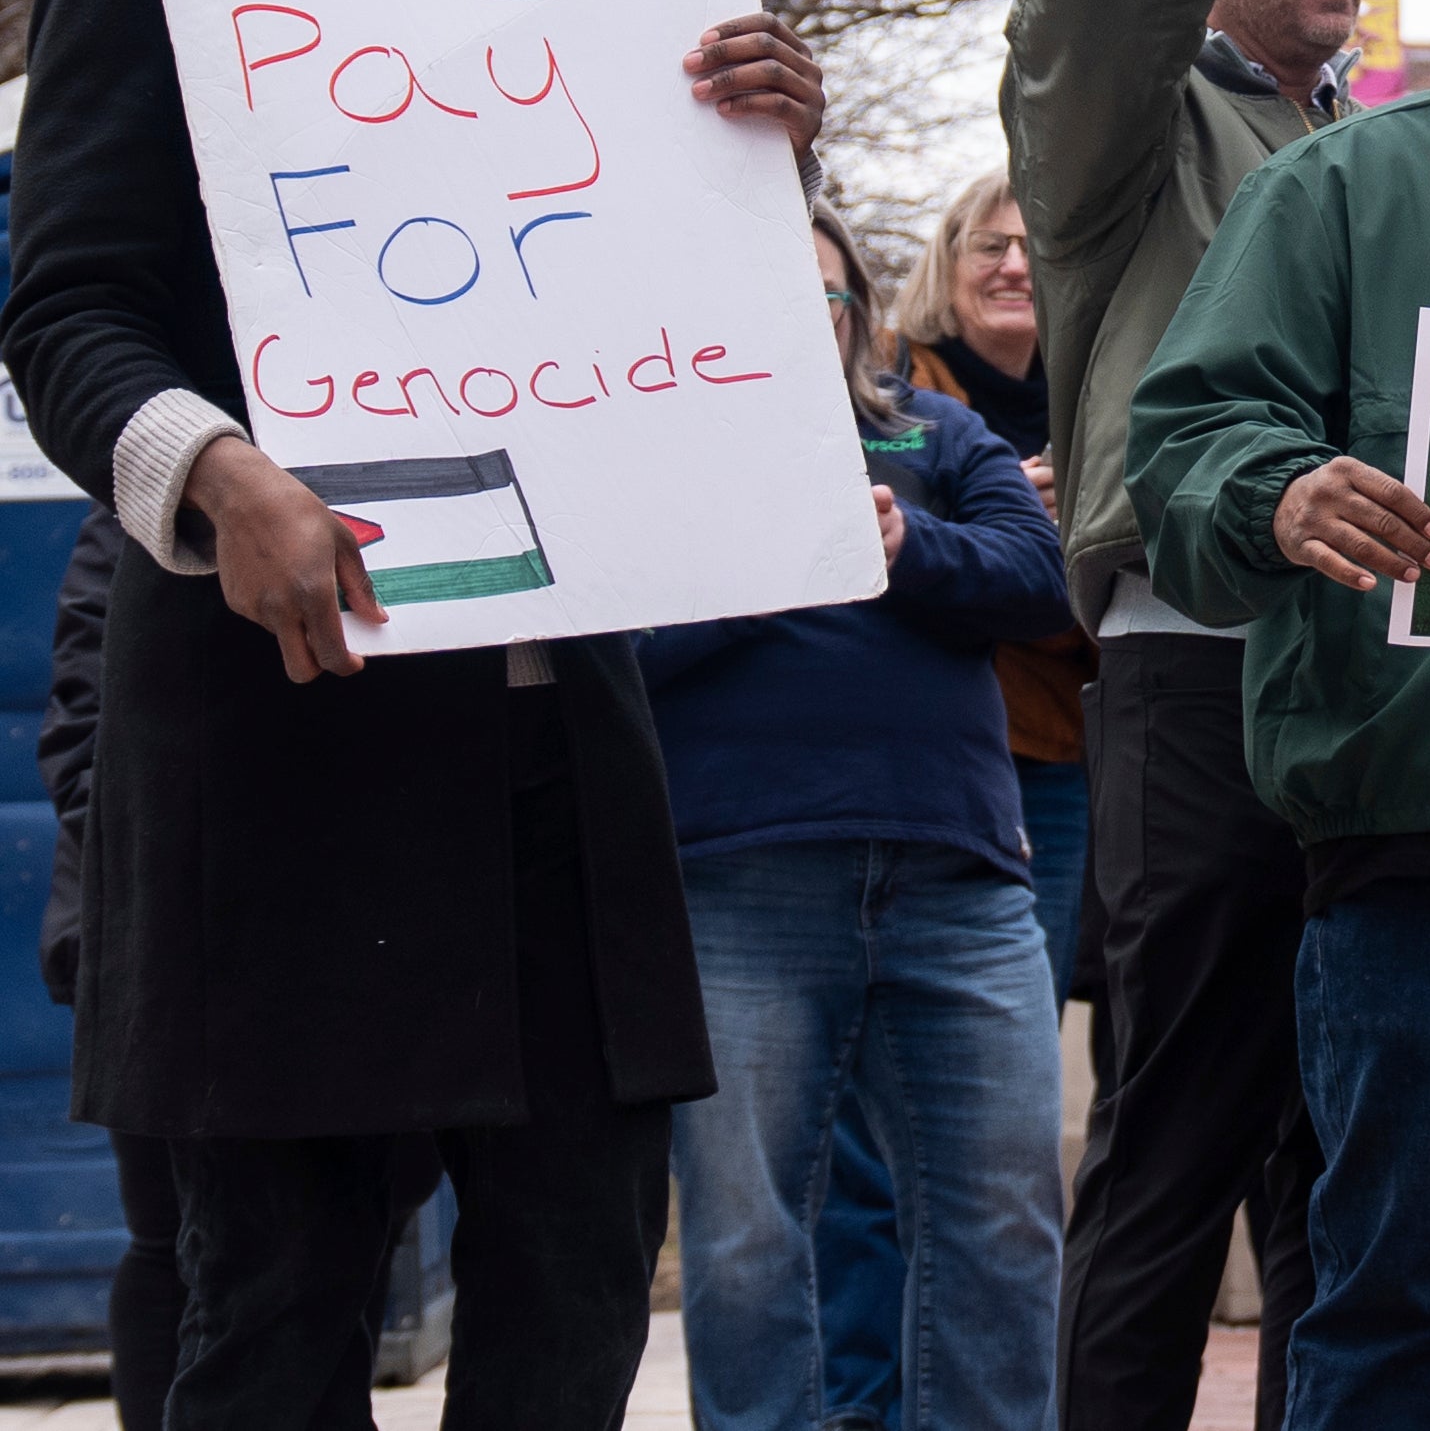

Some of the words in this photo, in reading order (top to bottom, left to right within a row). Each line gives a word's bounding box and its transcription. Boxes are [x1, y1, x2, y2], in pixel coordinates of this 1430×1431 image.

[231, 2, 601, 201] Pay
[269, 164, 592, 306] For
[252, 327, 775, 421] Genocide
